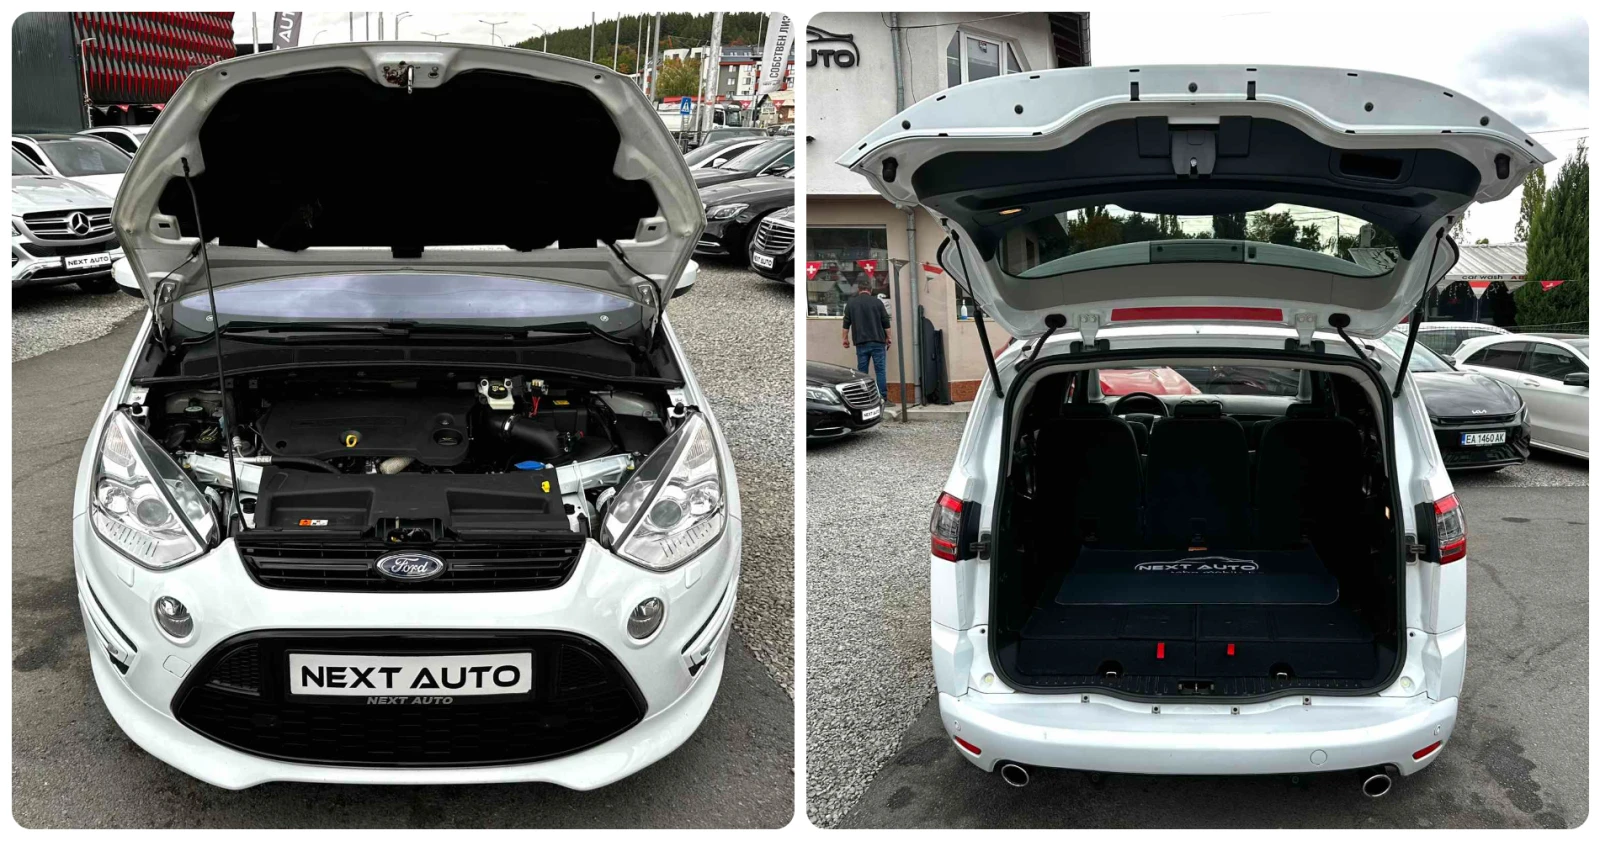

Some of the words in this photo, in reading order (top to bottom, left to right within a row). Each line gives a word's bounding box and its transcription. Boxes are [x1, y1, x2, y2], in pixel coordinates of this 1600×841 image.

[769, 35, 788, 79] СОБСТВЕН
[67, 258, 88, 266] NEXT
[90, 256, 109, 264] AUTO
[1466, 434, 1476, 444] EA
[1478, 433, 1495, 443] 1460
[1495, 432, 1505, 442] AK
[391, 557, 429, 573] Ford
[301, 665, 403, 689] NEXT
[409, 664, 521, 690] AUTO
[366, 696, 409, 705] NEXT
[411, 696, 454, 705] AUTO
